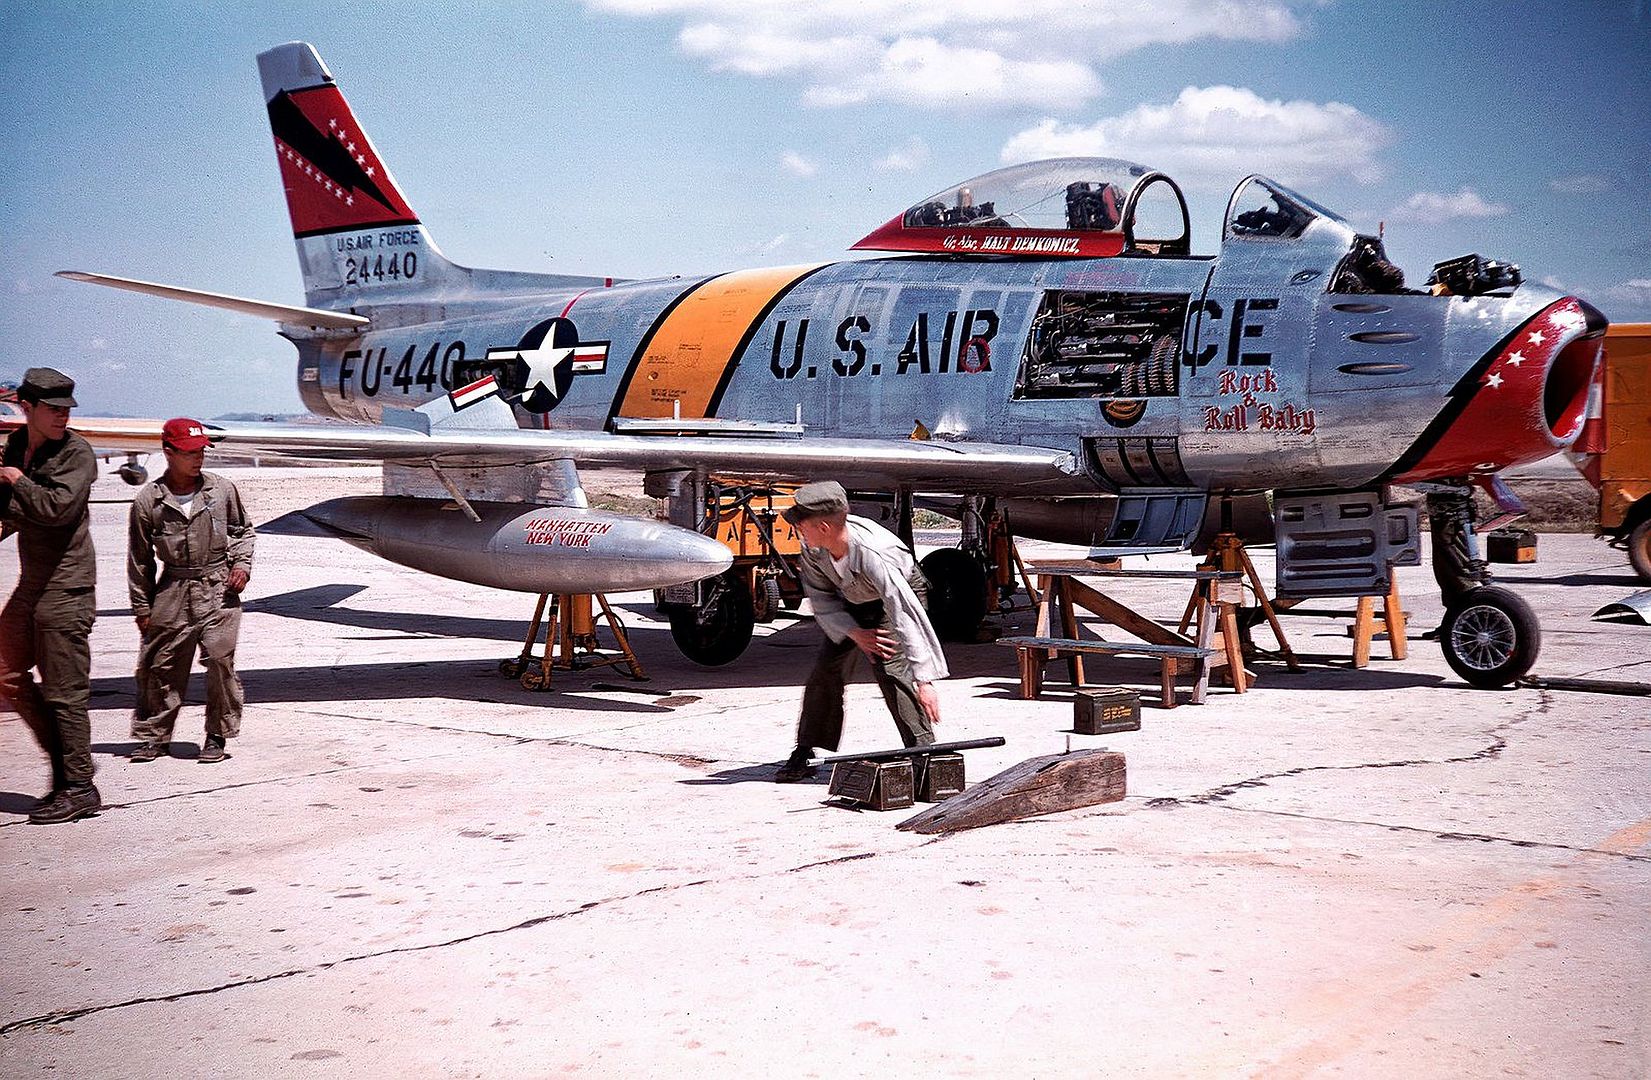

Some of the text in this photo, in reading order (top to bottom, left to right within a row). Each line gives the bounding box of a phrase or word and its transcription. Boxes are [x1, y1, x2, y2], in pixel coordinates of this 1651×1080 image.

[379, 230, 419, 248] FORCE
[345, 251, 417, 285] 24440
[770, 316, 882, 380] U.S.
[896, 309, 1000, 375] AIR
[339, 340, 466, 399] FU-440
[1219, 367, 1278, 396] Rock
[1241, 391, 1258, 408] &
[1204, 402, 1317, 435] Roll Baby
[524, 519, 615, 535] MANHATTEN
[525, 532, 594, 549] NEW YORK
